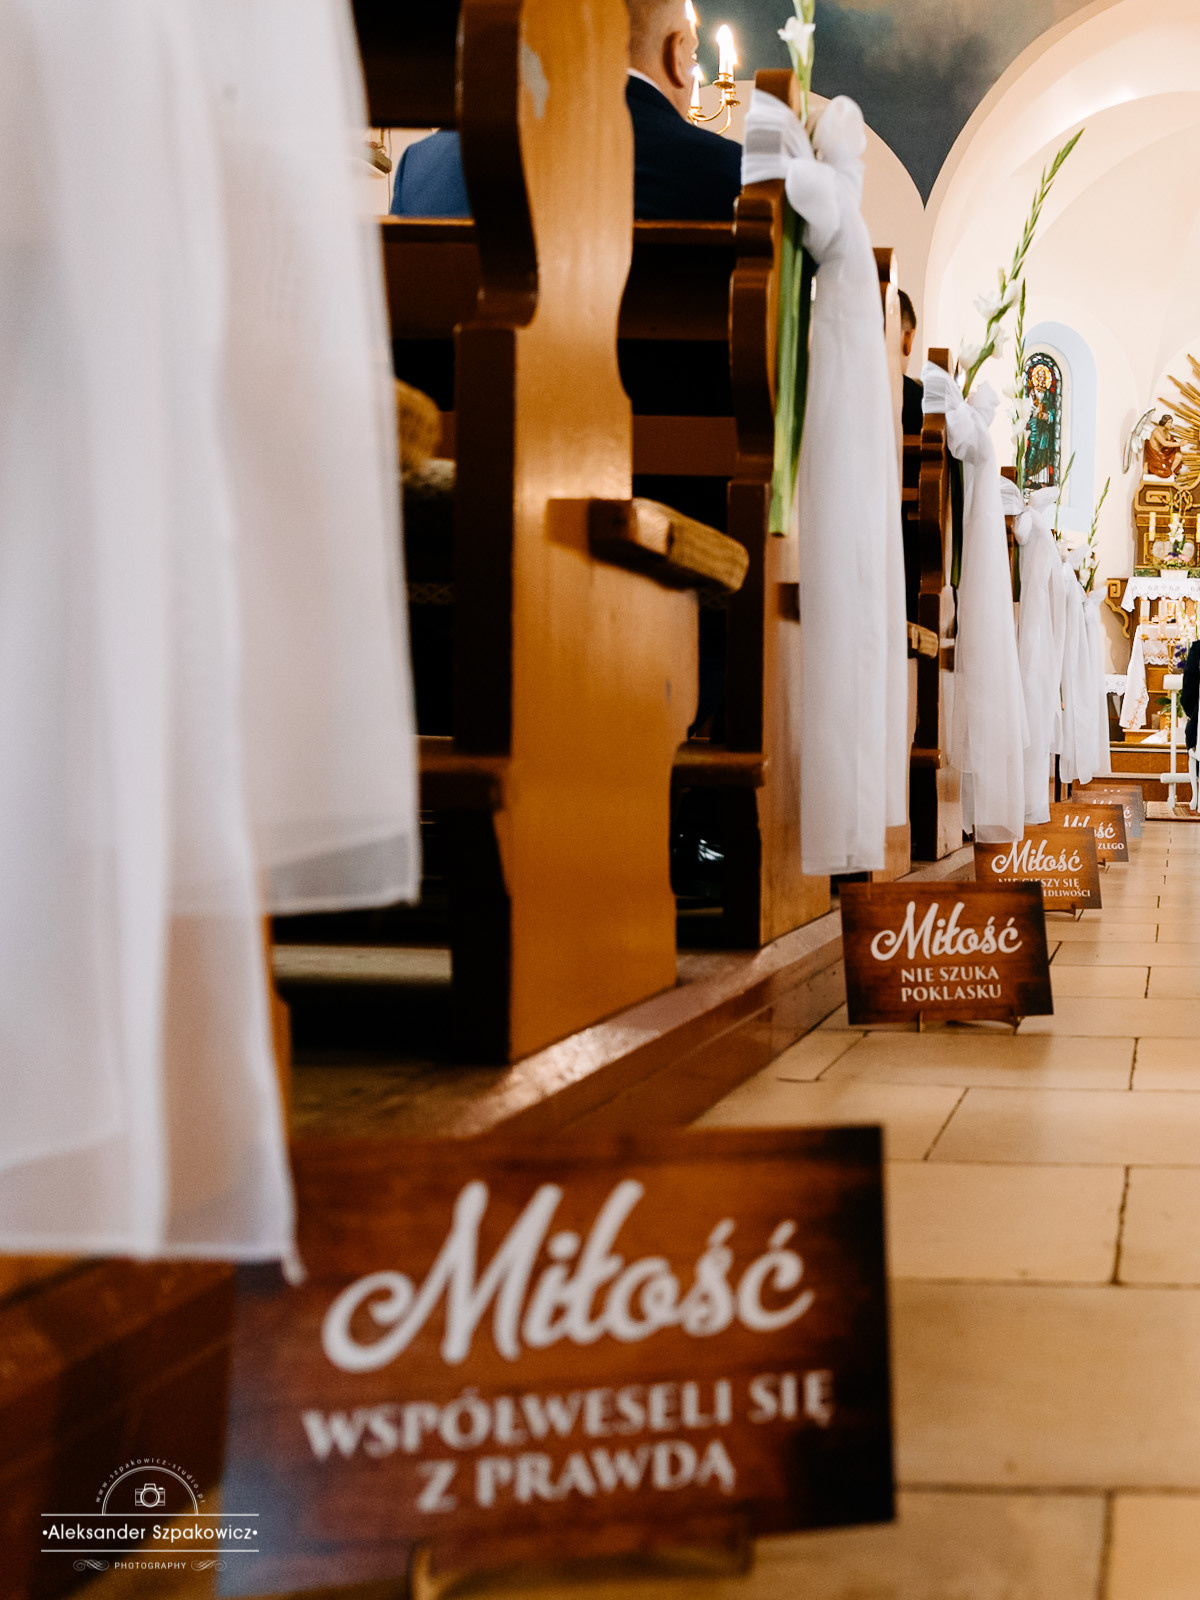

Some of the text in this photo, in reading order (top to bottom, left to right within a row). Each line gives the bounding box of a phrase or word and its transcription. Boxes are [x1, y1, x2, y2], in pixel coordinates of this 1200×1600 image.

[991, 838, 1083, 874] Miłość
[1062, 878, 1080, 890] SIĘ
[870, 900, 1023, 961] Miłość
[901, 965, 999, 983] NIE SZUKA
[901, 984, 1001, 1002] POKLASKU
[321, 1179, 815, 1373] Miłość
[748, 1369, 835, 1428] SIĘ
[415, 1438, 735, 1514] Z PRAWDĄ
